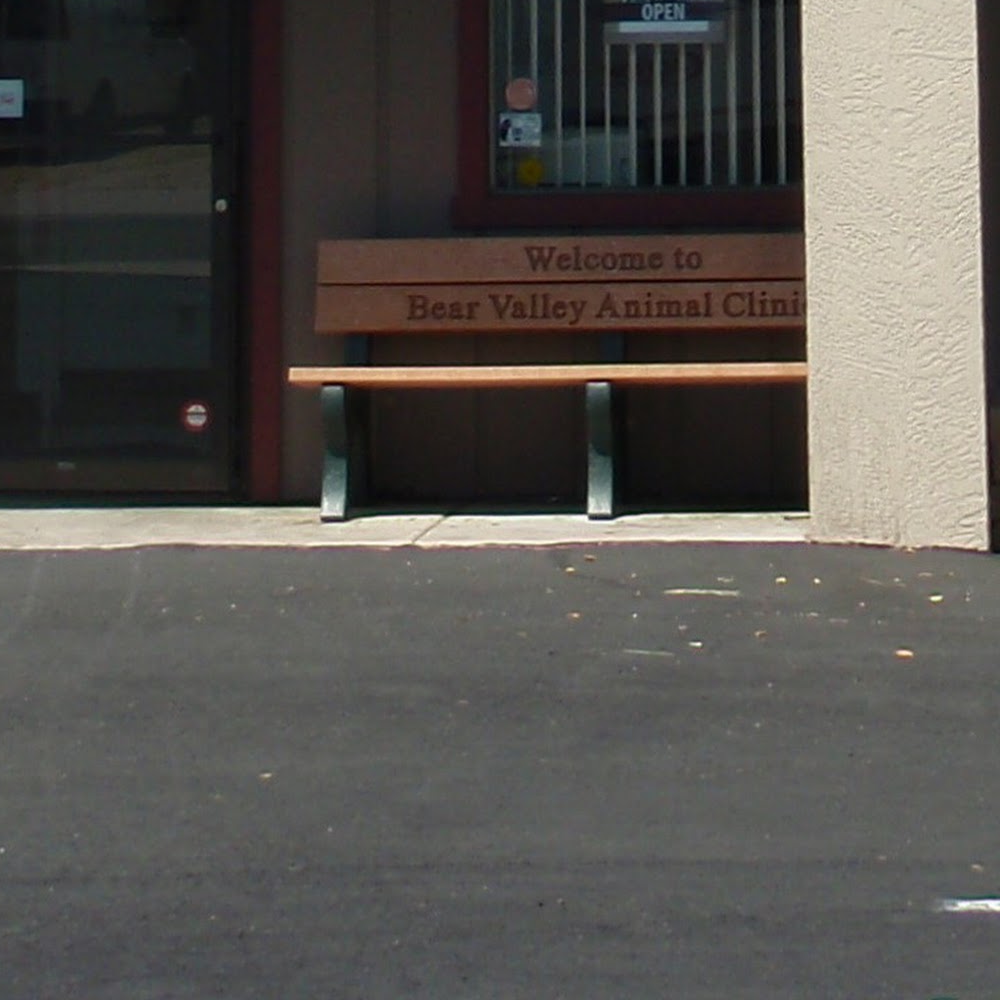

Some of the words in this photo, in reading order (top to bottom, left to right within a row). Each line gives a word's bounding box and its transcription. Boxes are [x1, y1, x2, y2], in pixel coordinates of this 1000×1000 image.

[641, 3, 685, 21] OPEN
[525, 246, 663, 271] Welcome
[674, 247, 702, 271] to
[407, 294, 480, 320] Bear
[488, 293, 586, 324] Valley
[596, 292, 712, 319] Animal
[722, 291, 804, 317] Clini
